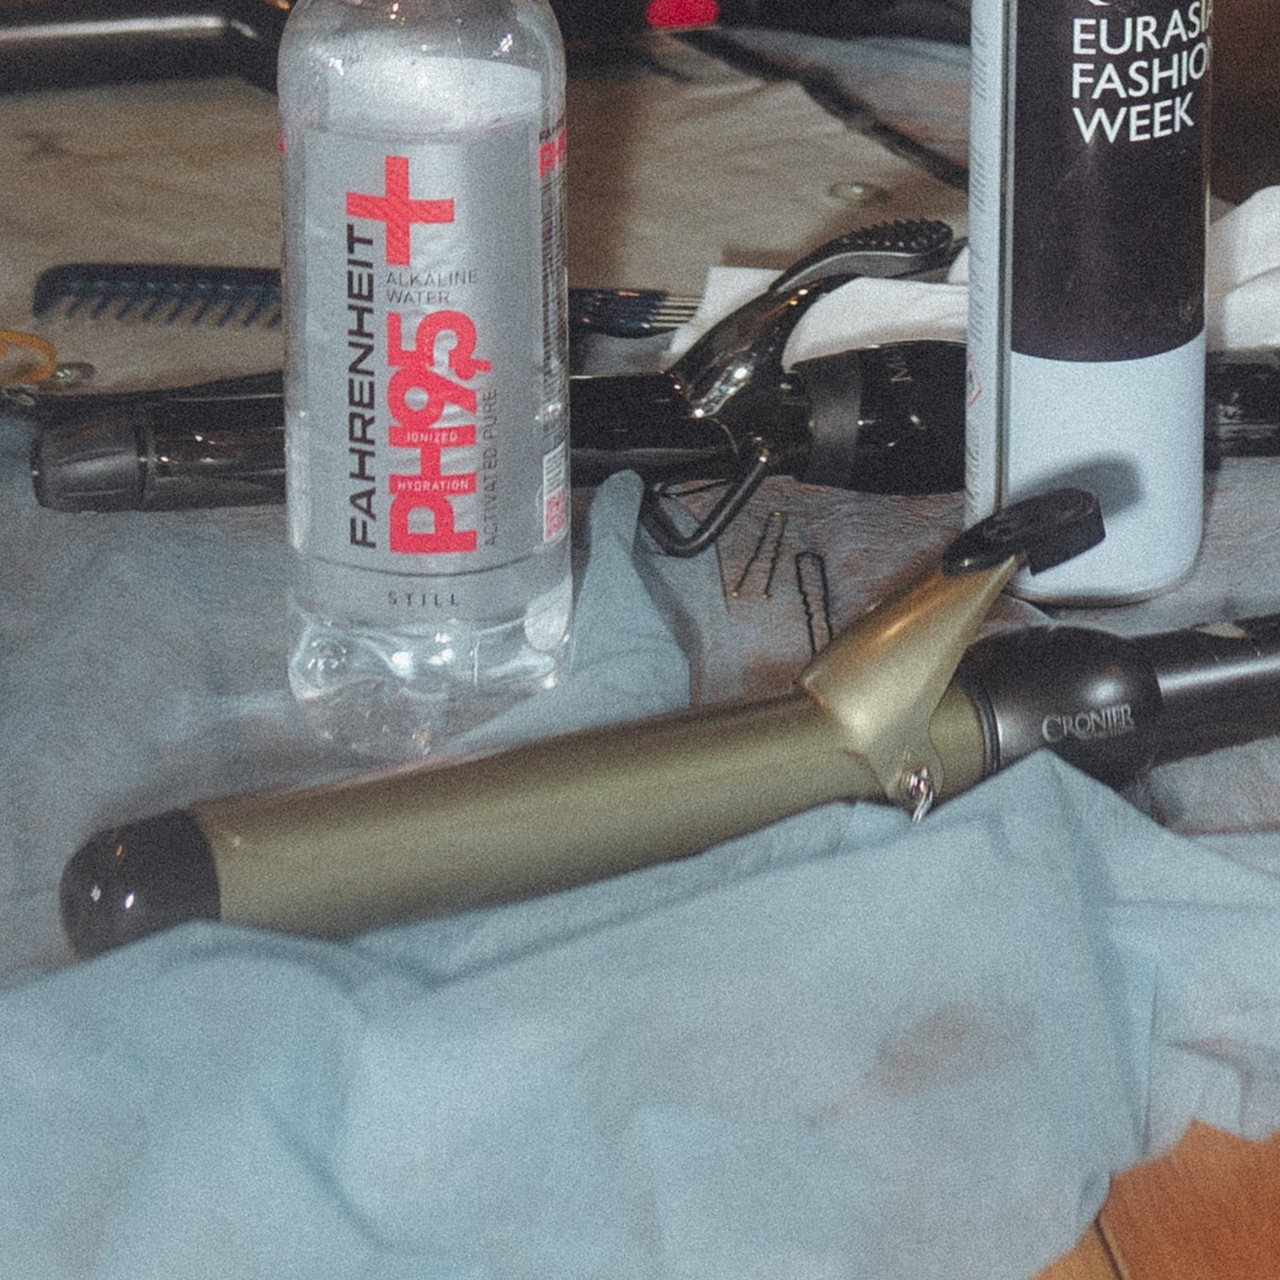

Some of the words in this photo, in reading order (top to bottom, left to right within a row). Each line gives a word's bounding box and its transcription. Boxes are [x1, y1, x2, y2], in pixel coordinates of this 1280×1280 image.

[1072, 92, 1194, 144] WEEK
[386, 268, 478, 287] ALKALINE
[386, 289, 450, 304] WATER
[347, 223, 376, 548] FAHRENHEIT
[482, 389, 498, 440] PURE
[405, 431, 458, 444] IONIZED
[397, 478, 469, 492] HYDRATION
[482, 447, 498, 546] ACTIVATED
[388, 590, 459, 608] STILL
